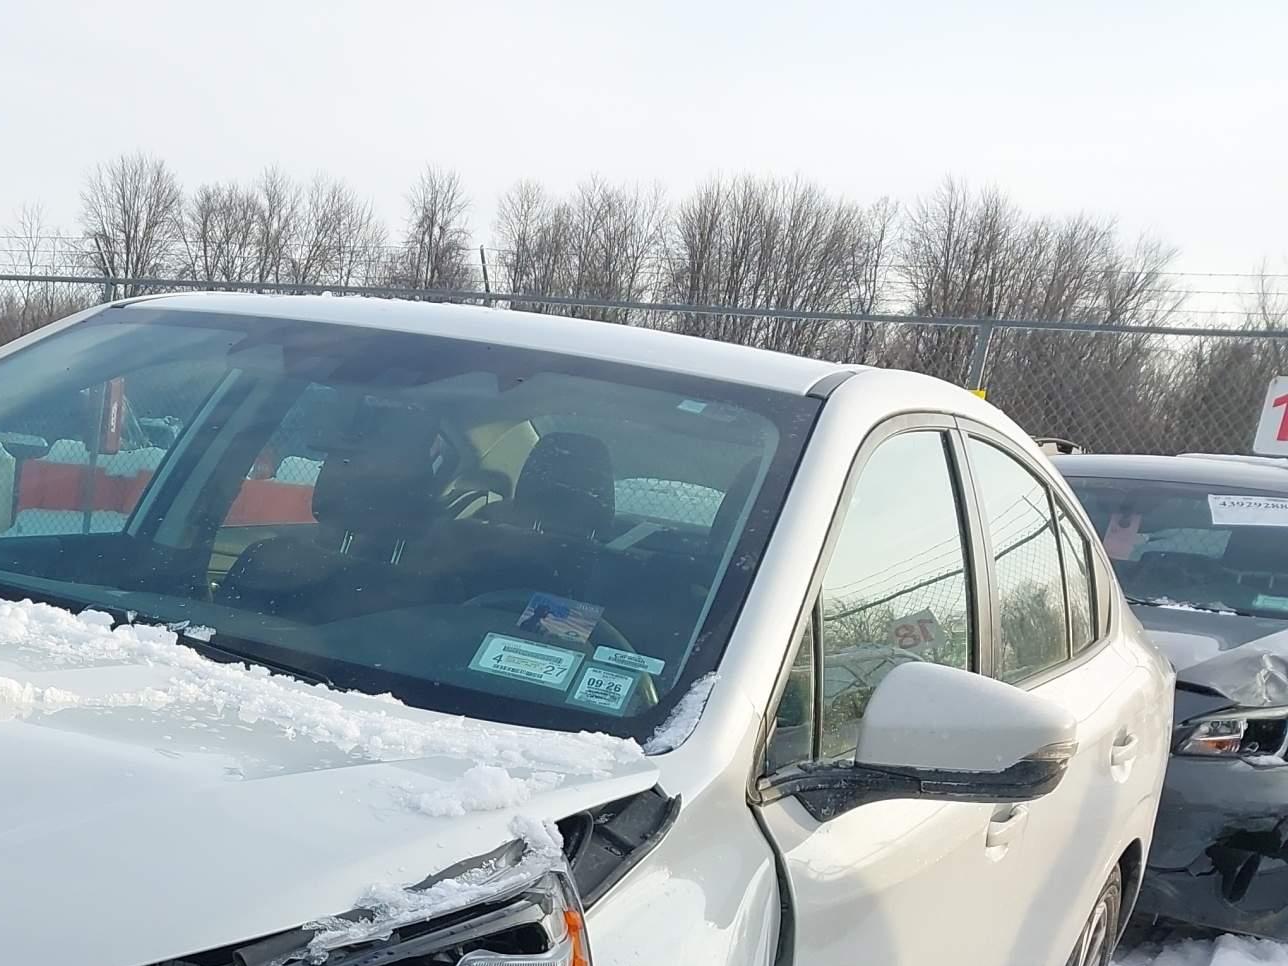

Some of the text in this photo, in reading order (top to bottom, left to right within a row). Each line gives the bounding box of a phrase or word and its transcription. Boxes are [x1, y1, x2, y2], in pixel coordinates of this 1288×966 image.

[493, 654, 503, 663] 4
[543, 665, 567, 677] 27
[587, 677, 623, 692] 09 26
